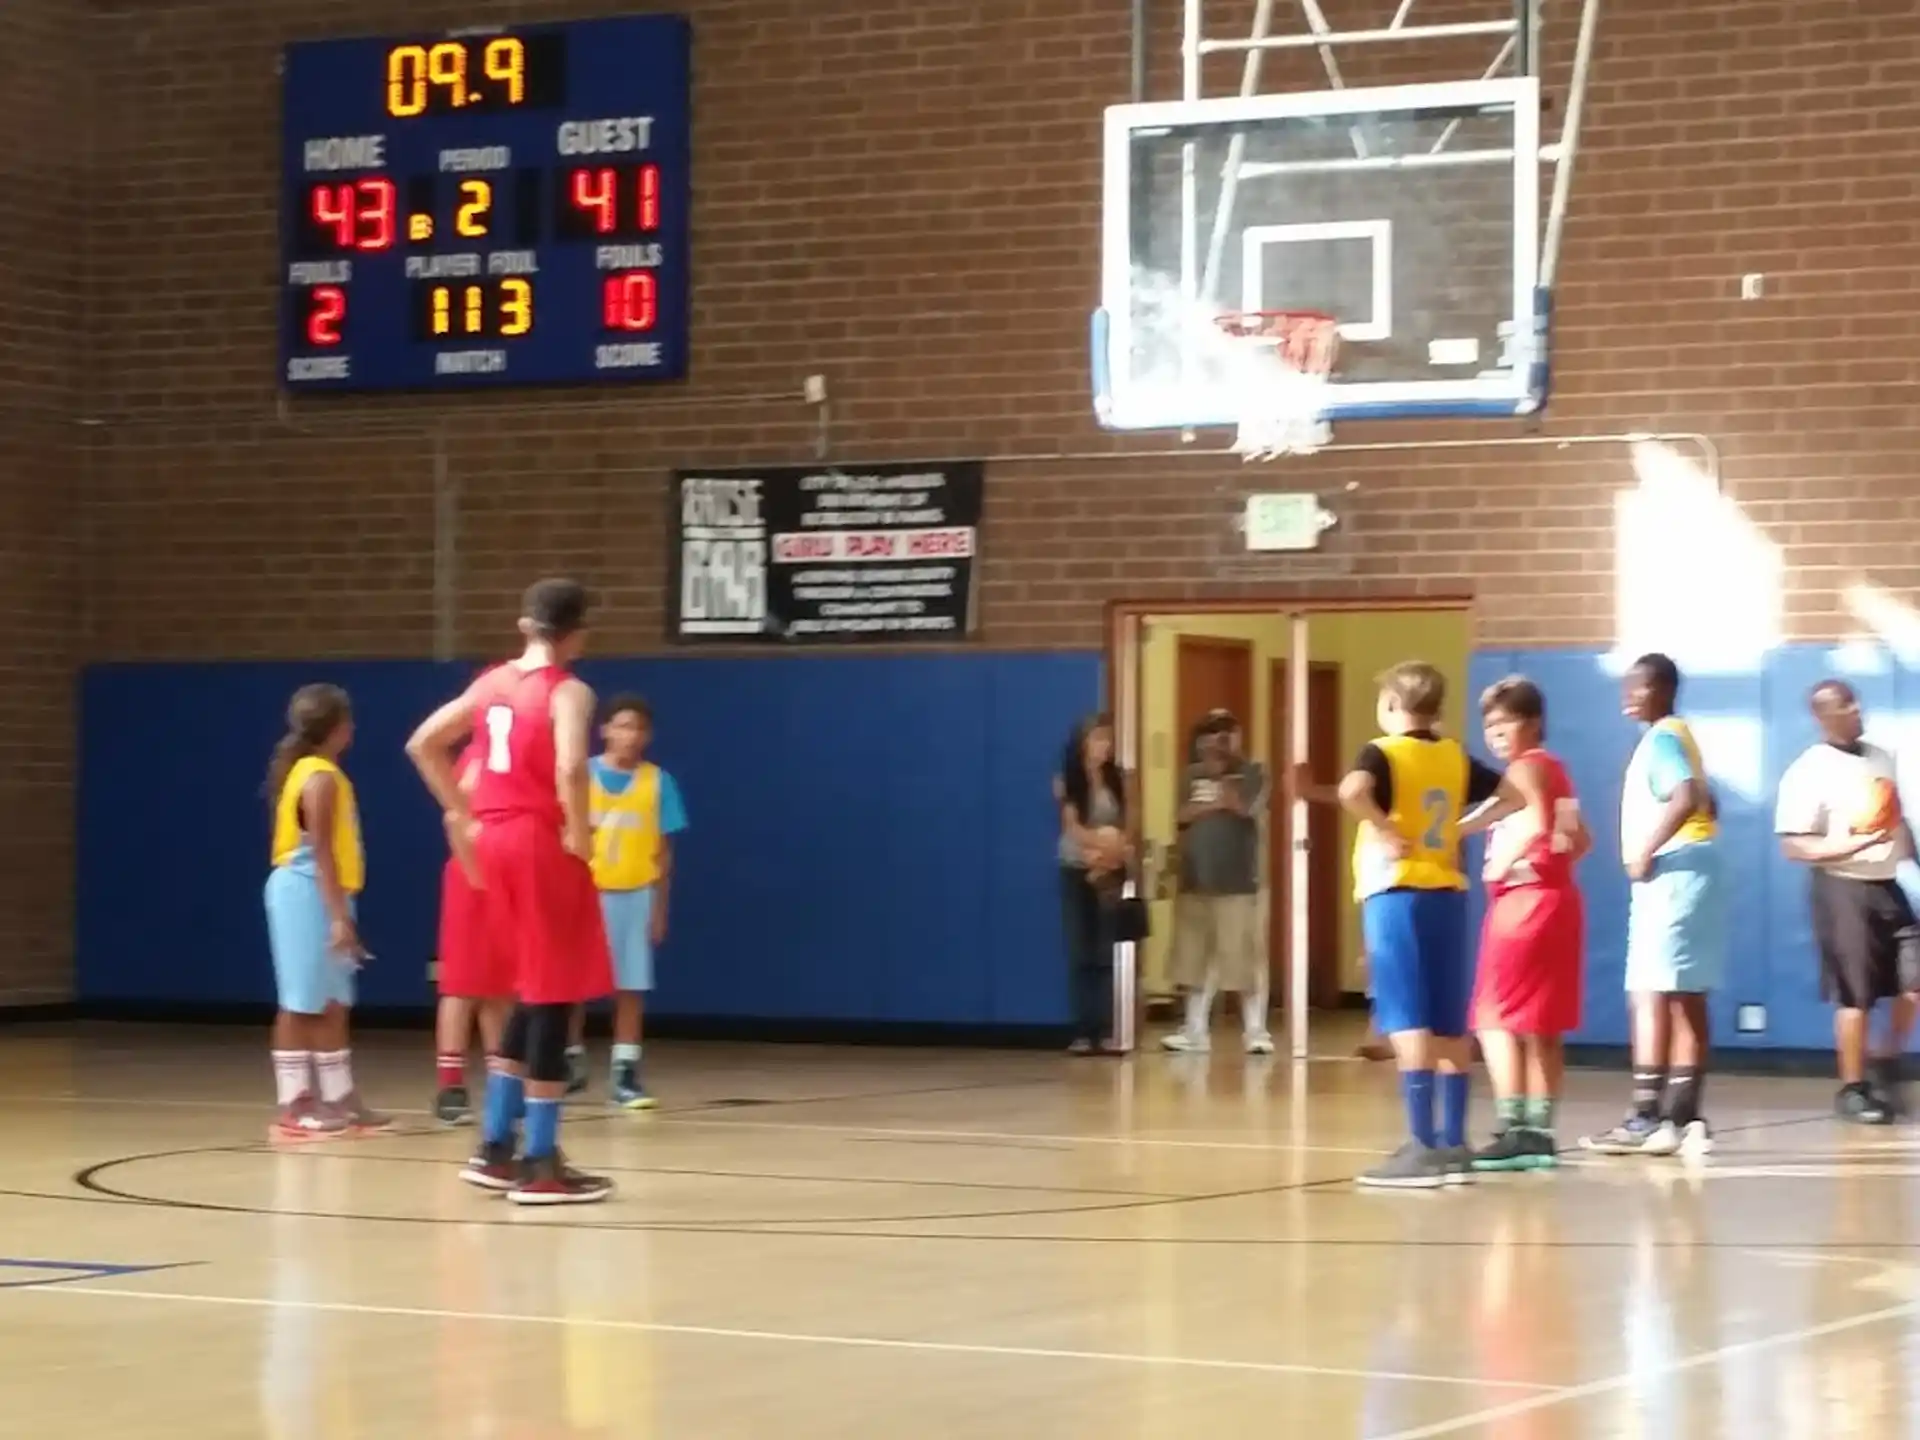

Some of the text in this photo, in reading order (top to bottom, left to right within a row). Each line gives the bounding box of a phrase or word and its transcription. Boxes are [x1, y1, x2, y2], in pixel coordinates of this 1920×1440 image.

[388, 37, 524, 117] 09.9
[305, 134, 387, 171] HOME
[558, 117, 655, 155] GUEST
[312, 175, 397, 252] 43
[457, 180, 491, 236] 2
[571, 164, 660, 233] 41
[308, 284, 346, 345] 2
[604, 270, 657, 331] 10
[1421, 787, 1448, 849] 2
